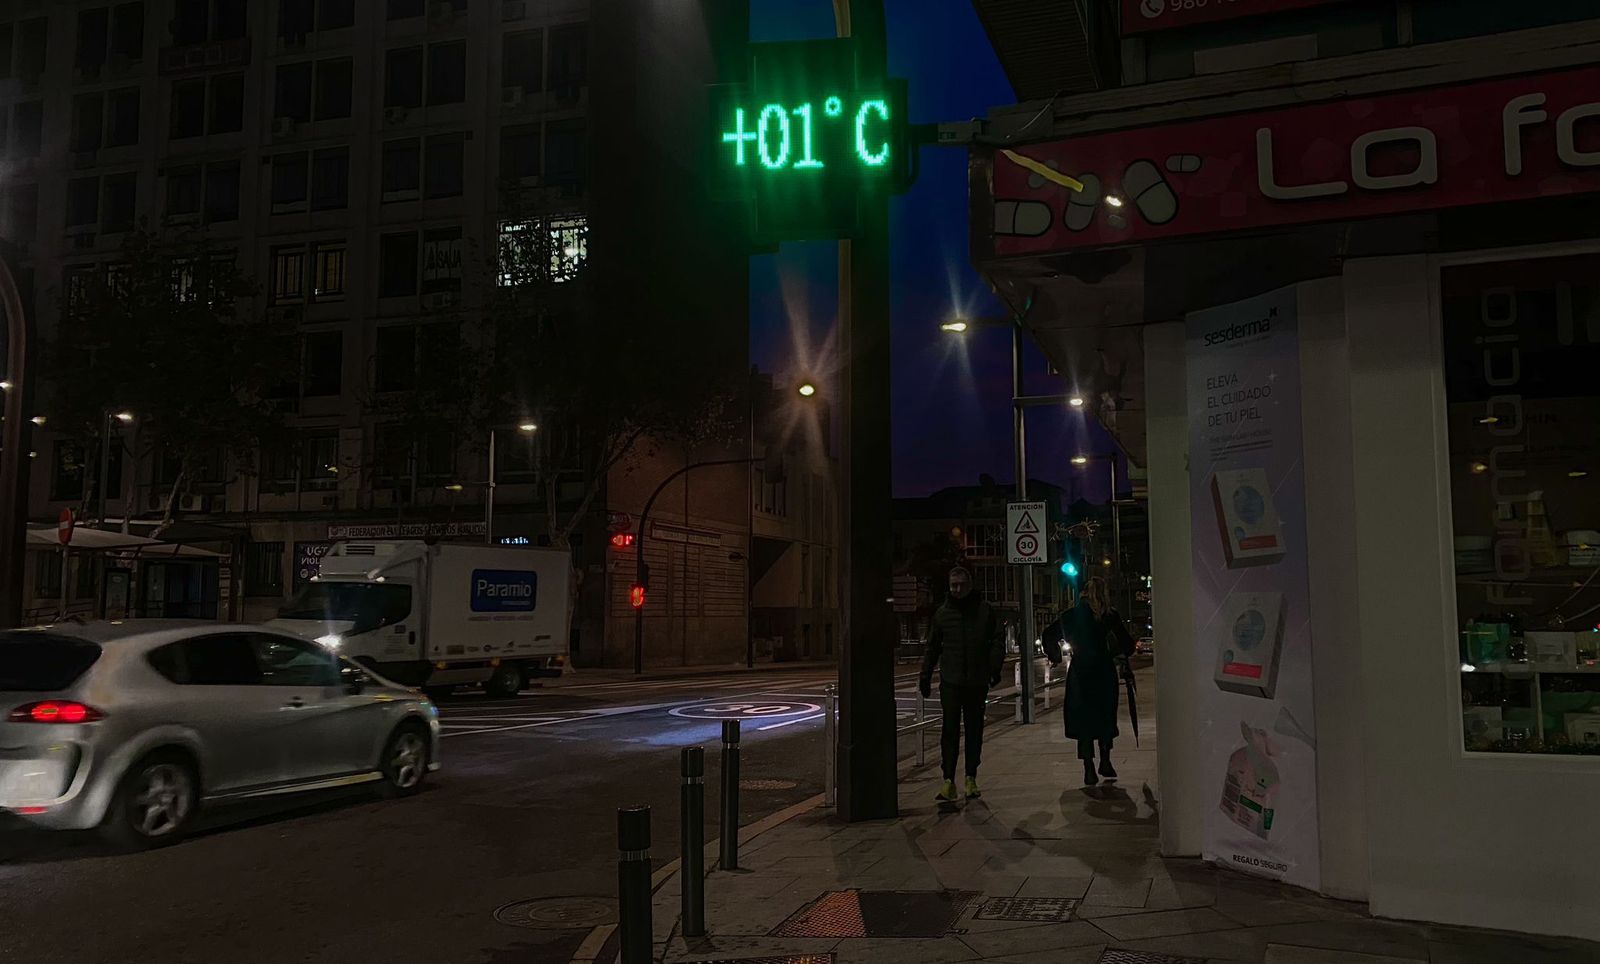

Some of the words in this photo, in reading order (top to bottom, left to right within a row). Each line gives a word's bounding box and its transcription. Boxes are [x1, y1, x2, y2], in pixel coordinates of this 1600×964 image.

[1255, 125, 1440, 201] La
[1204, 317, 1271, 347] sesderma
[1207, 373, 1238, 390] ELEVA
[1207, 396, 1219, 409] EL
[1221, 385, 1272, 405] CUIDADO
[1208, 413, 1221, 427] DE
[1224, 411, 1238, 424] TU
[1240, 406, 1262, 422] PIEL
[307, 546, 328, 556] UGT
[1020, 541, 1033, 549] 30
[477, 579, 533, 598] Paramio
[703, 704, 792, 714] 30
[1232, 854, 1260, 866] REGALO
[1260, 859, 1288, 873] SEGURO
